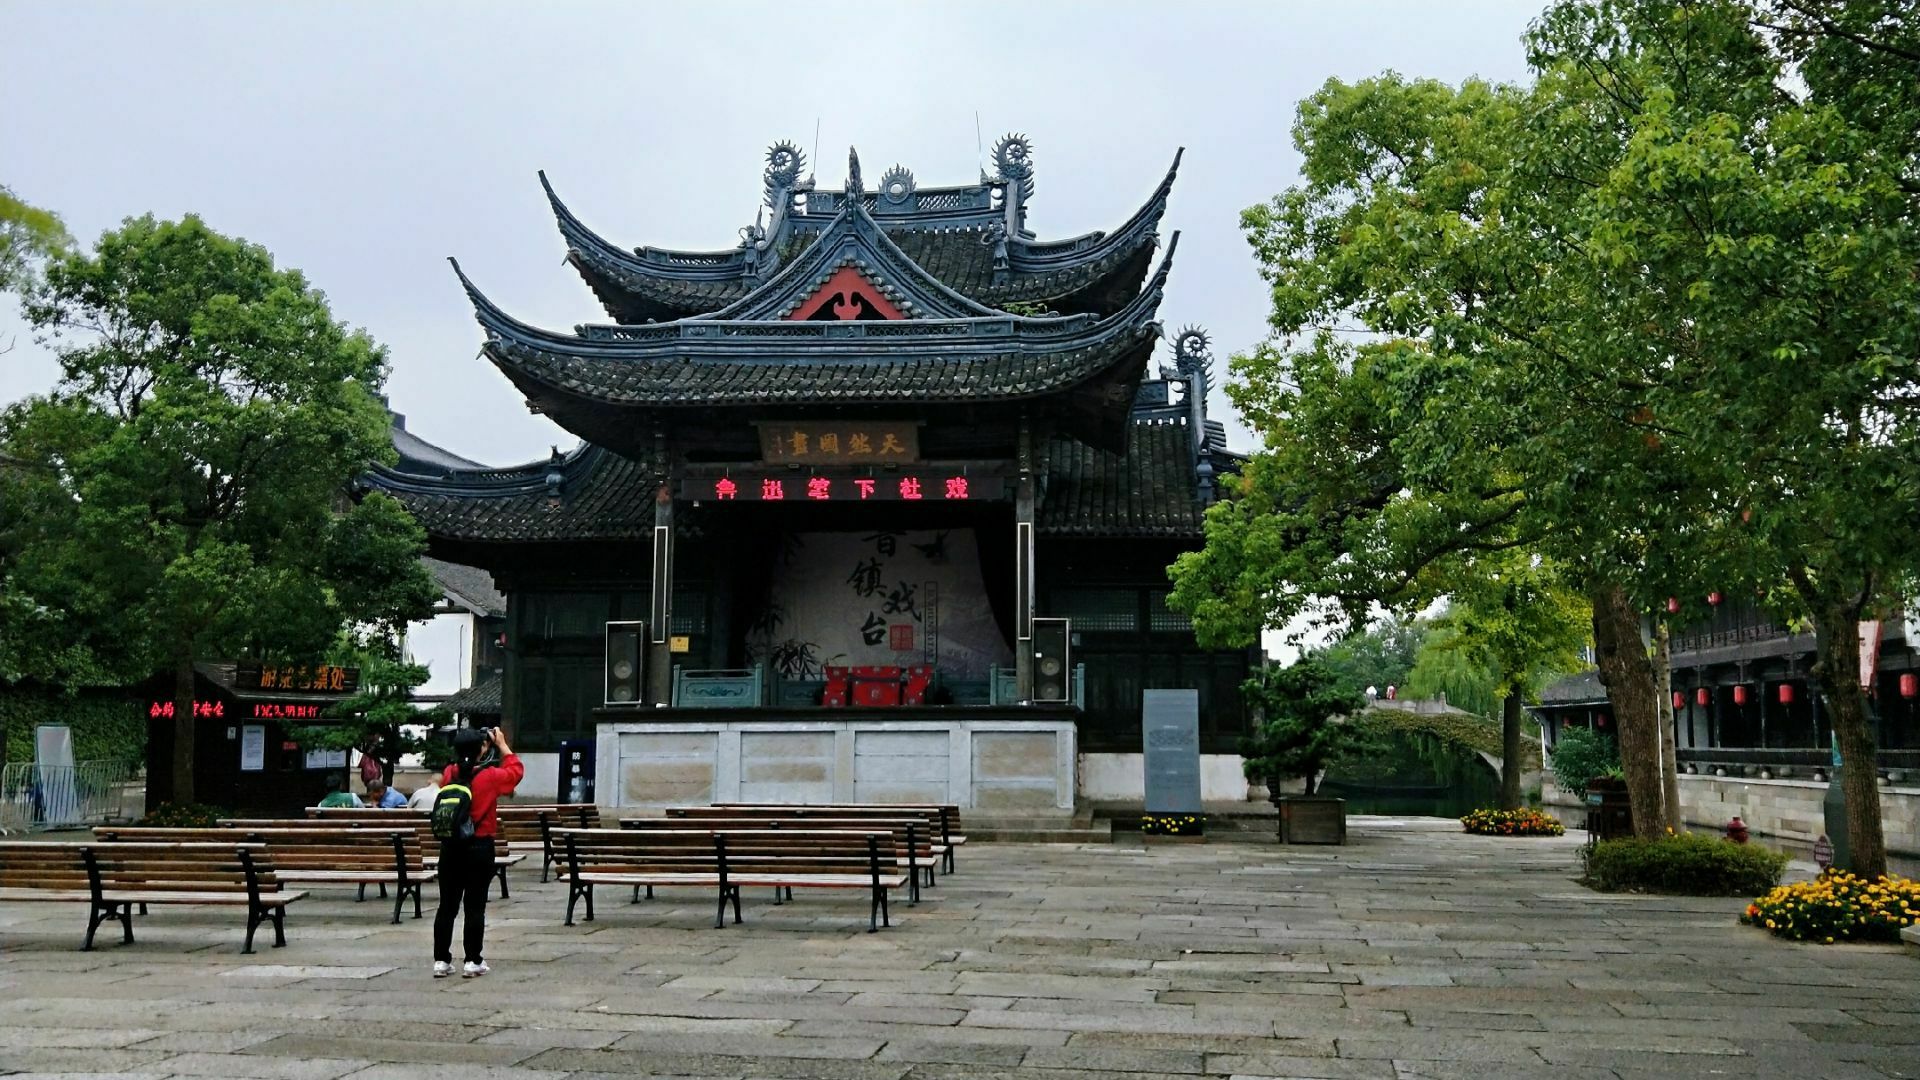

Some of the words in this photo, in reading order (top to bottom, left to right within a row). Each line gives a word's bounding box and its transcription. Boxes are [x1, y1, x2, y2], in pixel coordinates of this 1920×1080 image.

[714, 476, 969, 501] 鲁迅笔下社戏
